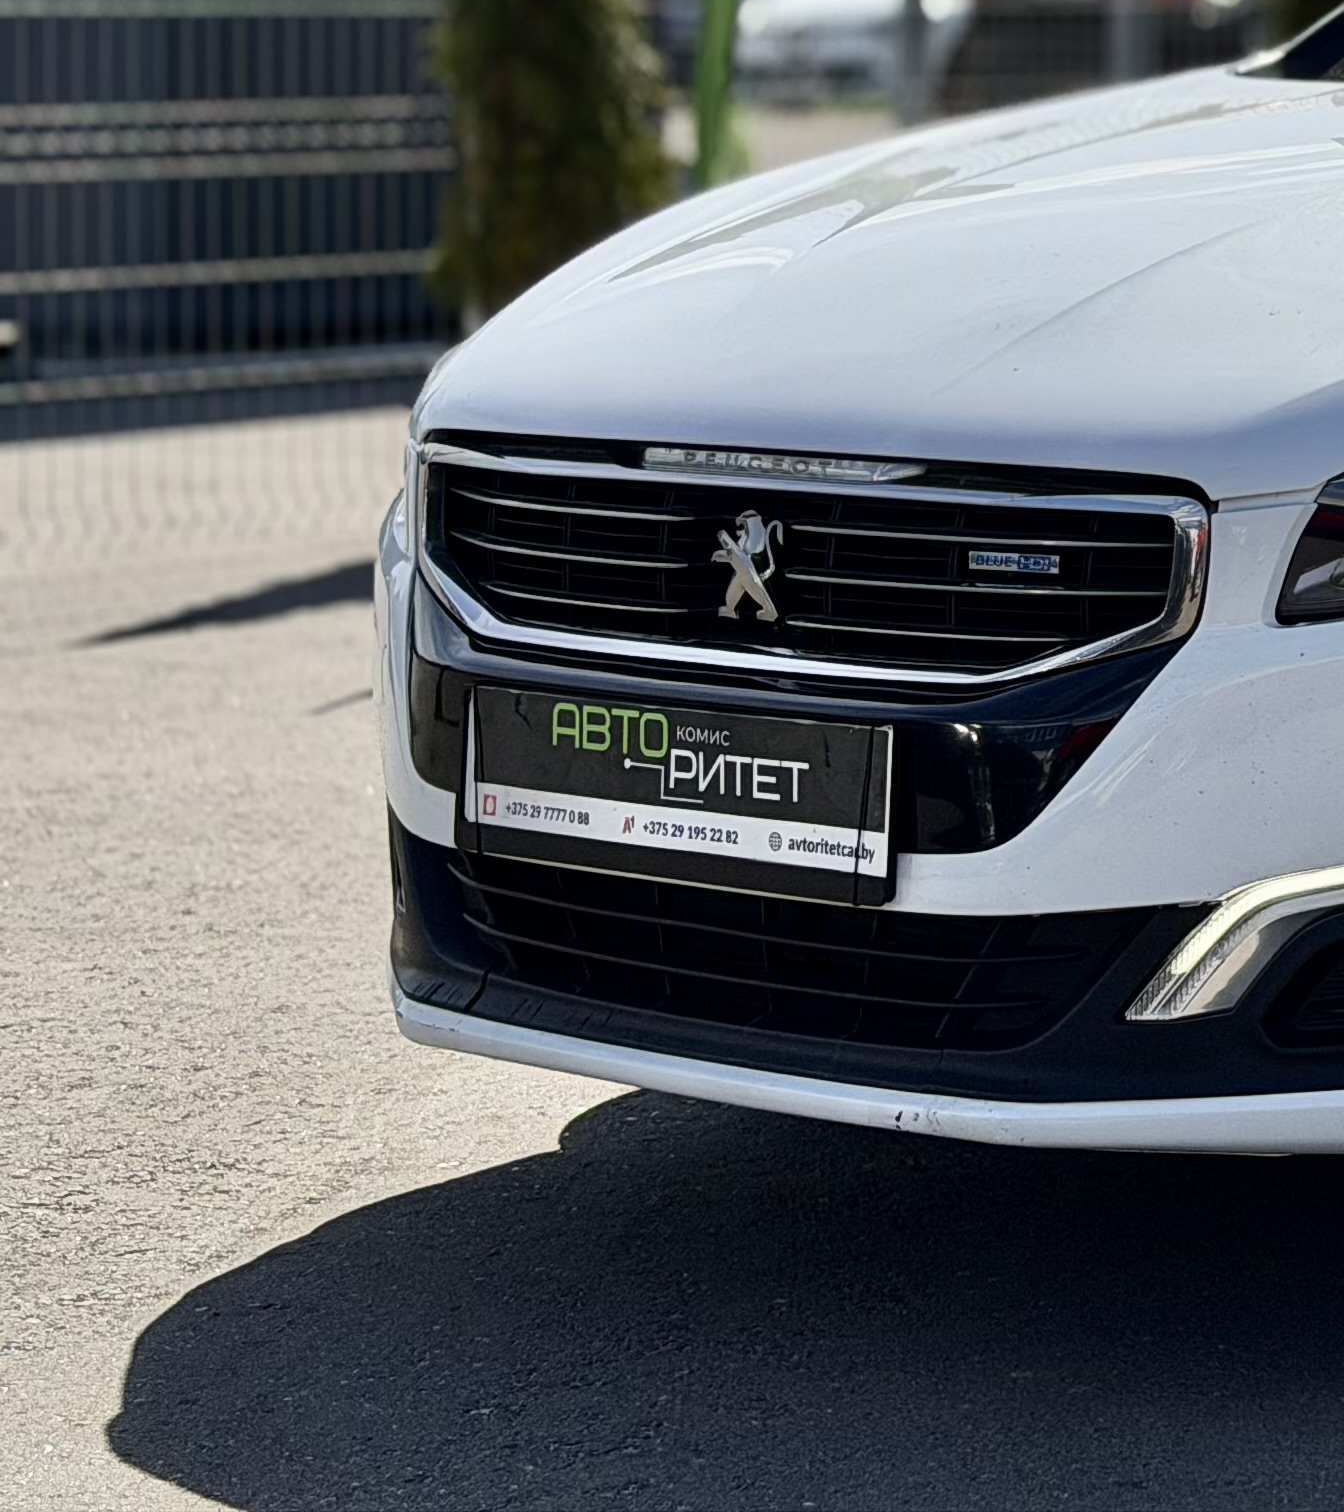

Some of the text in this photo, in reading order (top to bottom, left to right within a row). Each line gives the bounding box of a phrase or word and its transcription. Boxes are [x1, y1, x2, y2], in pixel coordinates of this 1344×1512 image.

[552, 702, 669, 758] АВТО
[676, 725, 731, 747] КОМИС
[668, 748, 810, 803] РИТЕТ
[505, 802, 590, 826] +375 29 7777 0 88
[642, 820, 739, 845] +375 29 195 22 82
